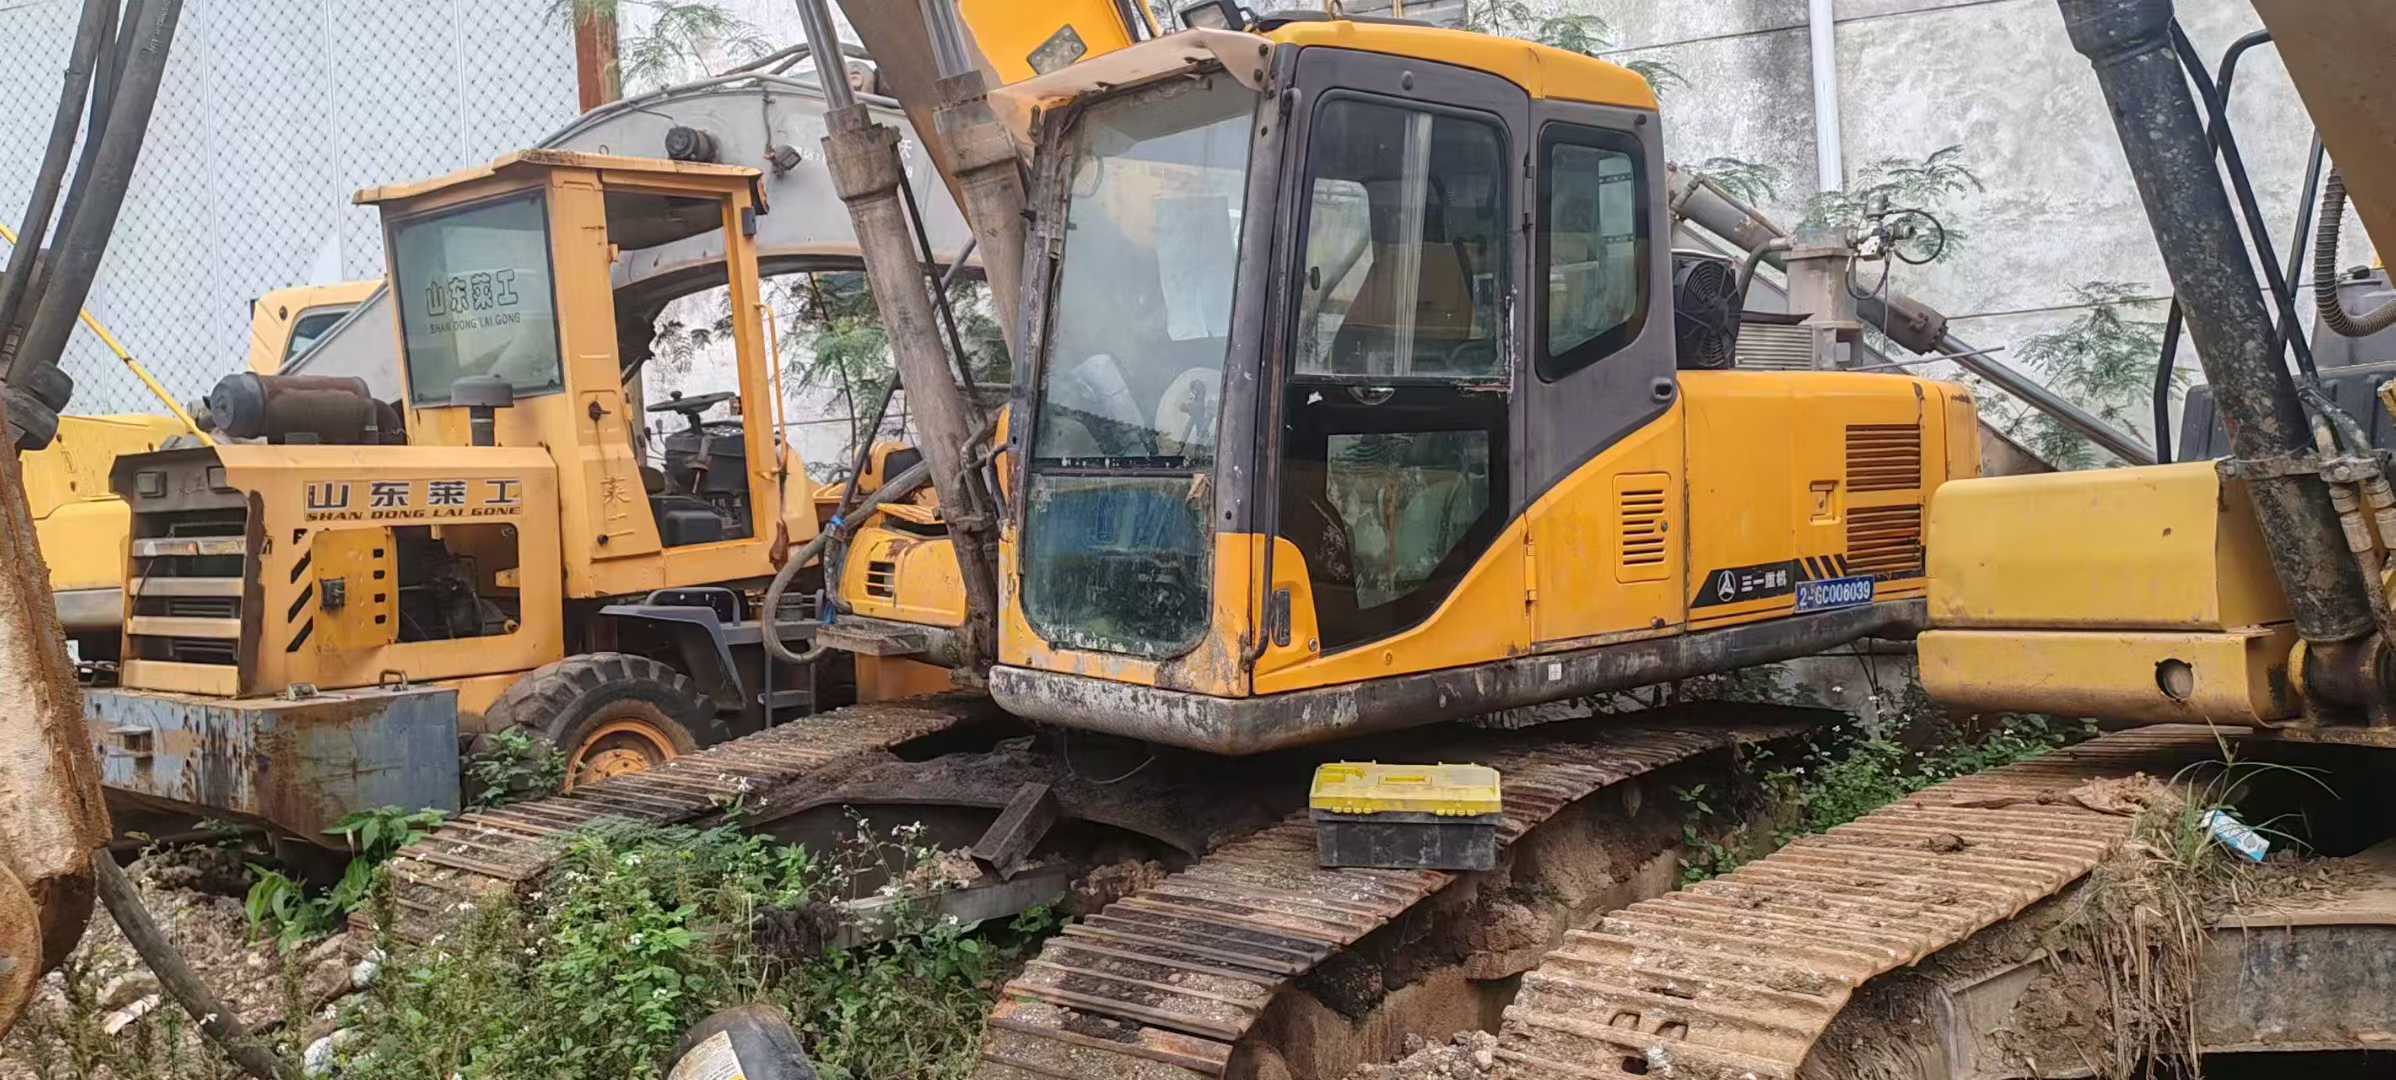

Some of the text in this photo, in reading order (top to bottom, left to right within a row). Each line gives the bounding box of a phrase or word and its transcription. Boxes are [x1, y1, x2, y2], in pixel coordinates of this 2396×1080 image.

[425, 269, 519, 317] 山东莱工
[430, 312, 520, 334] SHAN DONG LAI GONG
[307, 479, 521, 510] 山东莱工
[306, 511, 363, 521] SHAN
[370, 509, 425, 519] DONG
[432, 507, 463, 518] LAI
